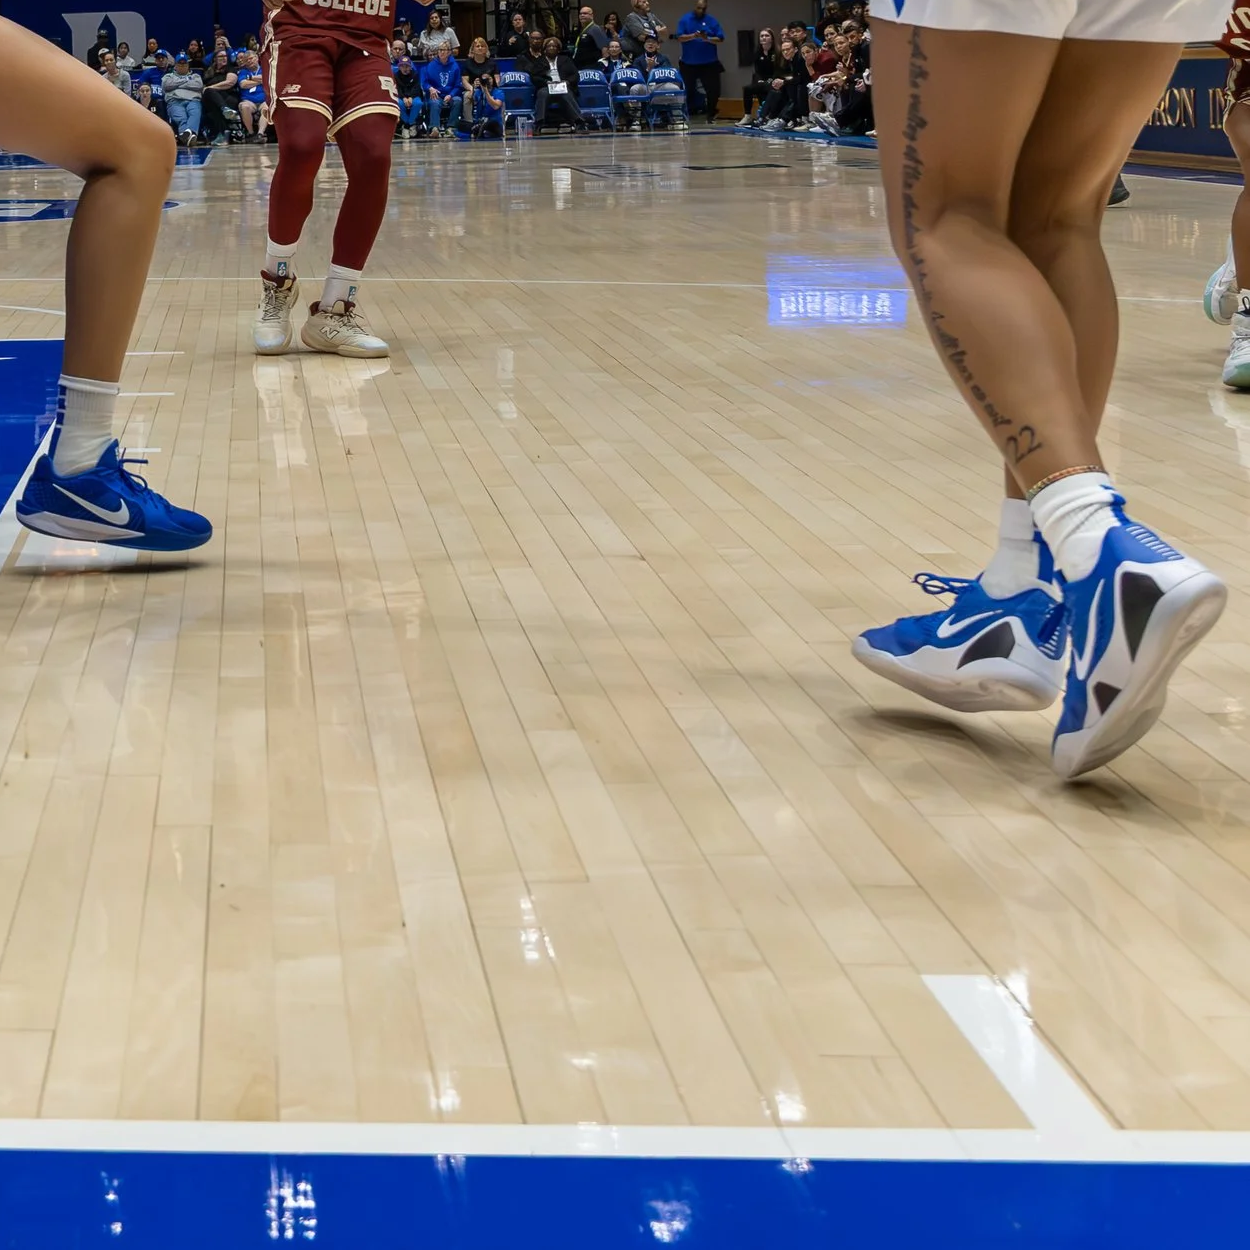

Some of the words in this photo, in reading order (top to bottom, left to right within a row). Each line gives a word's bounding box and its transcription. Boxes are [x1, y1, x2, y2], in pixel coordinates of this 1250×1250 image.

[504, 73, 526, 84] DUKE
[579, 71, 600, 82] DUKE
[616, 70, 638, 81] DUKE
[654, 68, 676, 80] DUKE
[152, 86, 163, 97] KE
